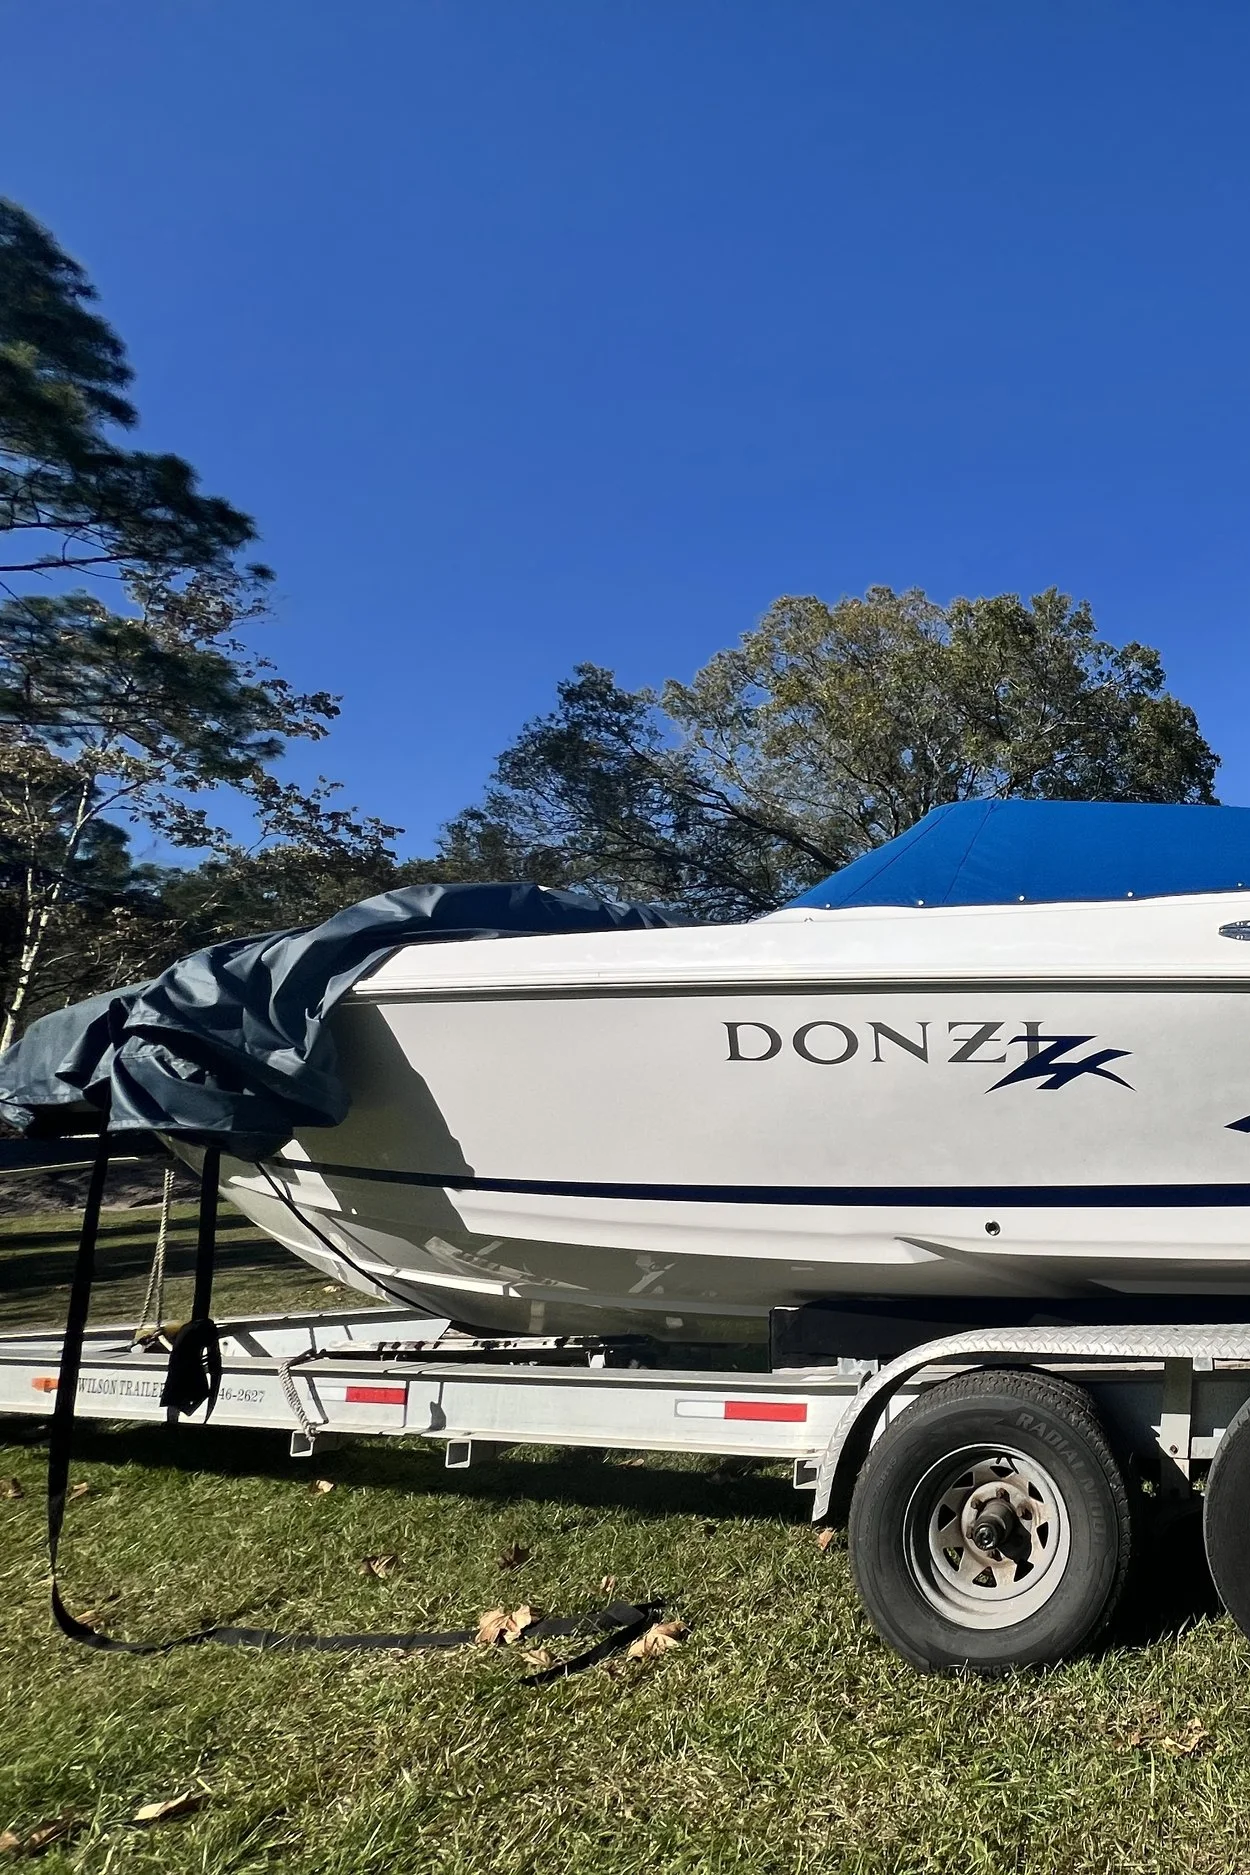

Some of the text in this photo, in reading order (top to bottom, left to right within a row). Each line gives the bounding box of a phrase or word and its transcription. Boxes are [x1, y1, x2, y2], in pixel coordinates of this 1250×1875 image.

[720, 1020, 1045, 1065] DONZI
[78, 1377, 117, 1396] WILSON
[218, 1387, 266, 1404] 46-2627
[1016, 1412, 1085, 1471] RADIAL
